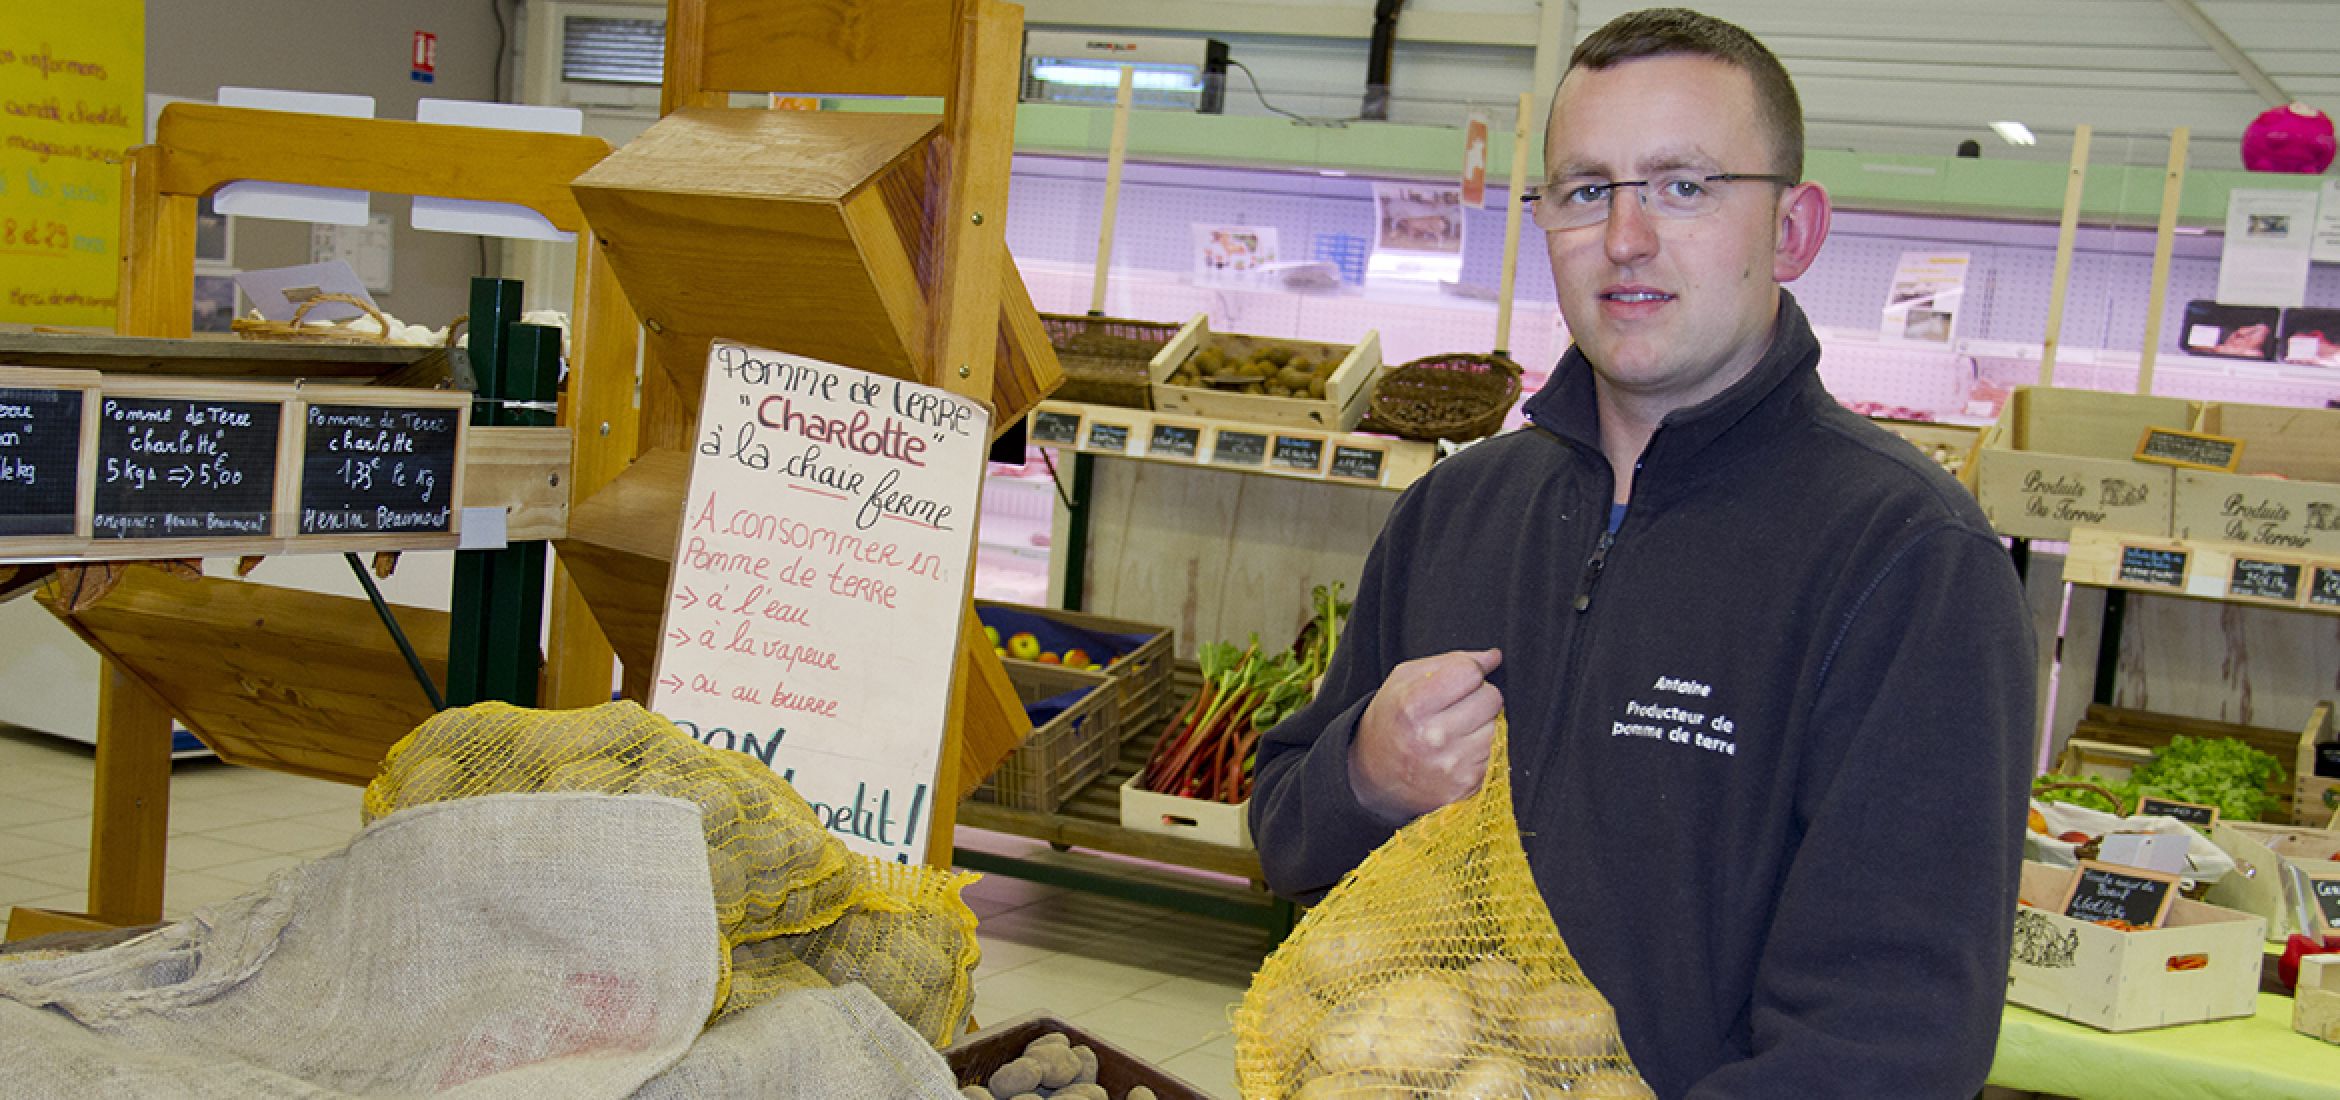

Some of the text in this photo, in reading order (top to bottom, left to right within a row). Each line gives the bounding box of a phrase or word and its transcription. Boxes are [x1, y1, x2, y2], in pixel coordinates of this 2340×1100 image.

[717, 345, 839, 401] Pomme
[850, 375, 881, 407] de
[105, 399, 253, 427] Pomme de Terre
[309, 405, 374, 427] Pomme
[380, 409, 398, 428] de
[106, 457, 120, 483] 5
[728, 421, 769, 470] la
[777, 444, 865, 495] chair
[855, 468, 953, 530] ferme
[2021, 469, 2085, 497] Produits
[2025, 495, 2107, 524] Du Terroir
[2219, 493, 2290, 520] Produits
[2223, 519, 2312, 549] Du Terroir
[683, 535, 771, 580] Pomme
[779, 555, 817, 589] de
[731, 583, 811, 627] l'eau
[699, 618, 841, 672] à la vapeur
[691, 673, 839, 718] ou au beurre
[1653, 675, 1712, 698] Antoine
[1626, 700, 1735, 735] Producteur de
[1668, 726, 1690, 744] de
[1695, 732, 1736, 756] terre
